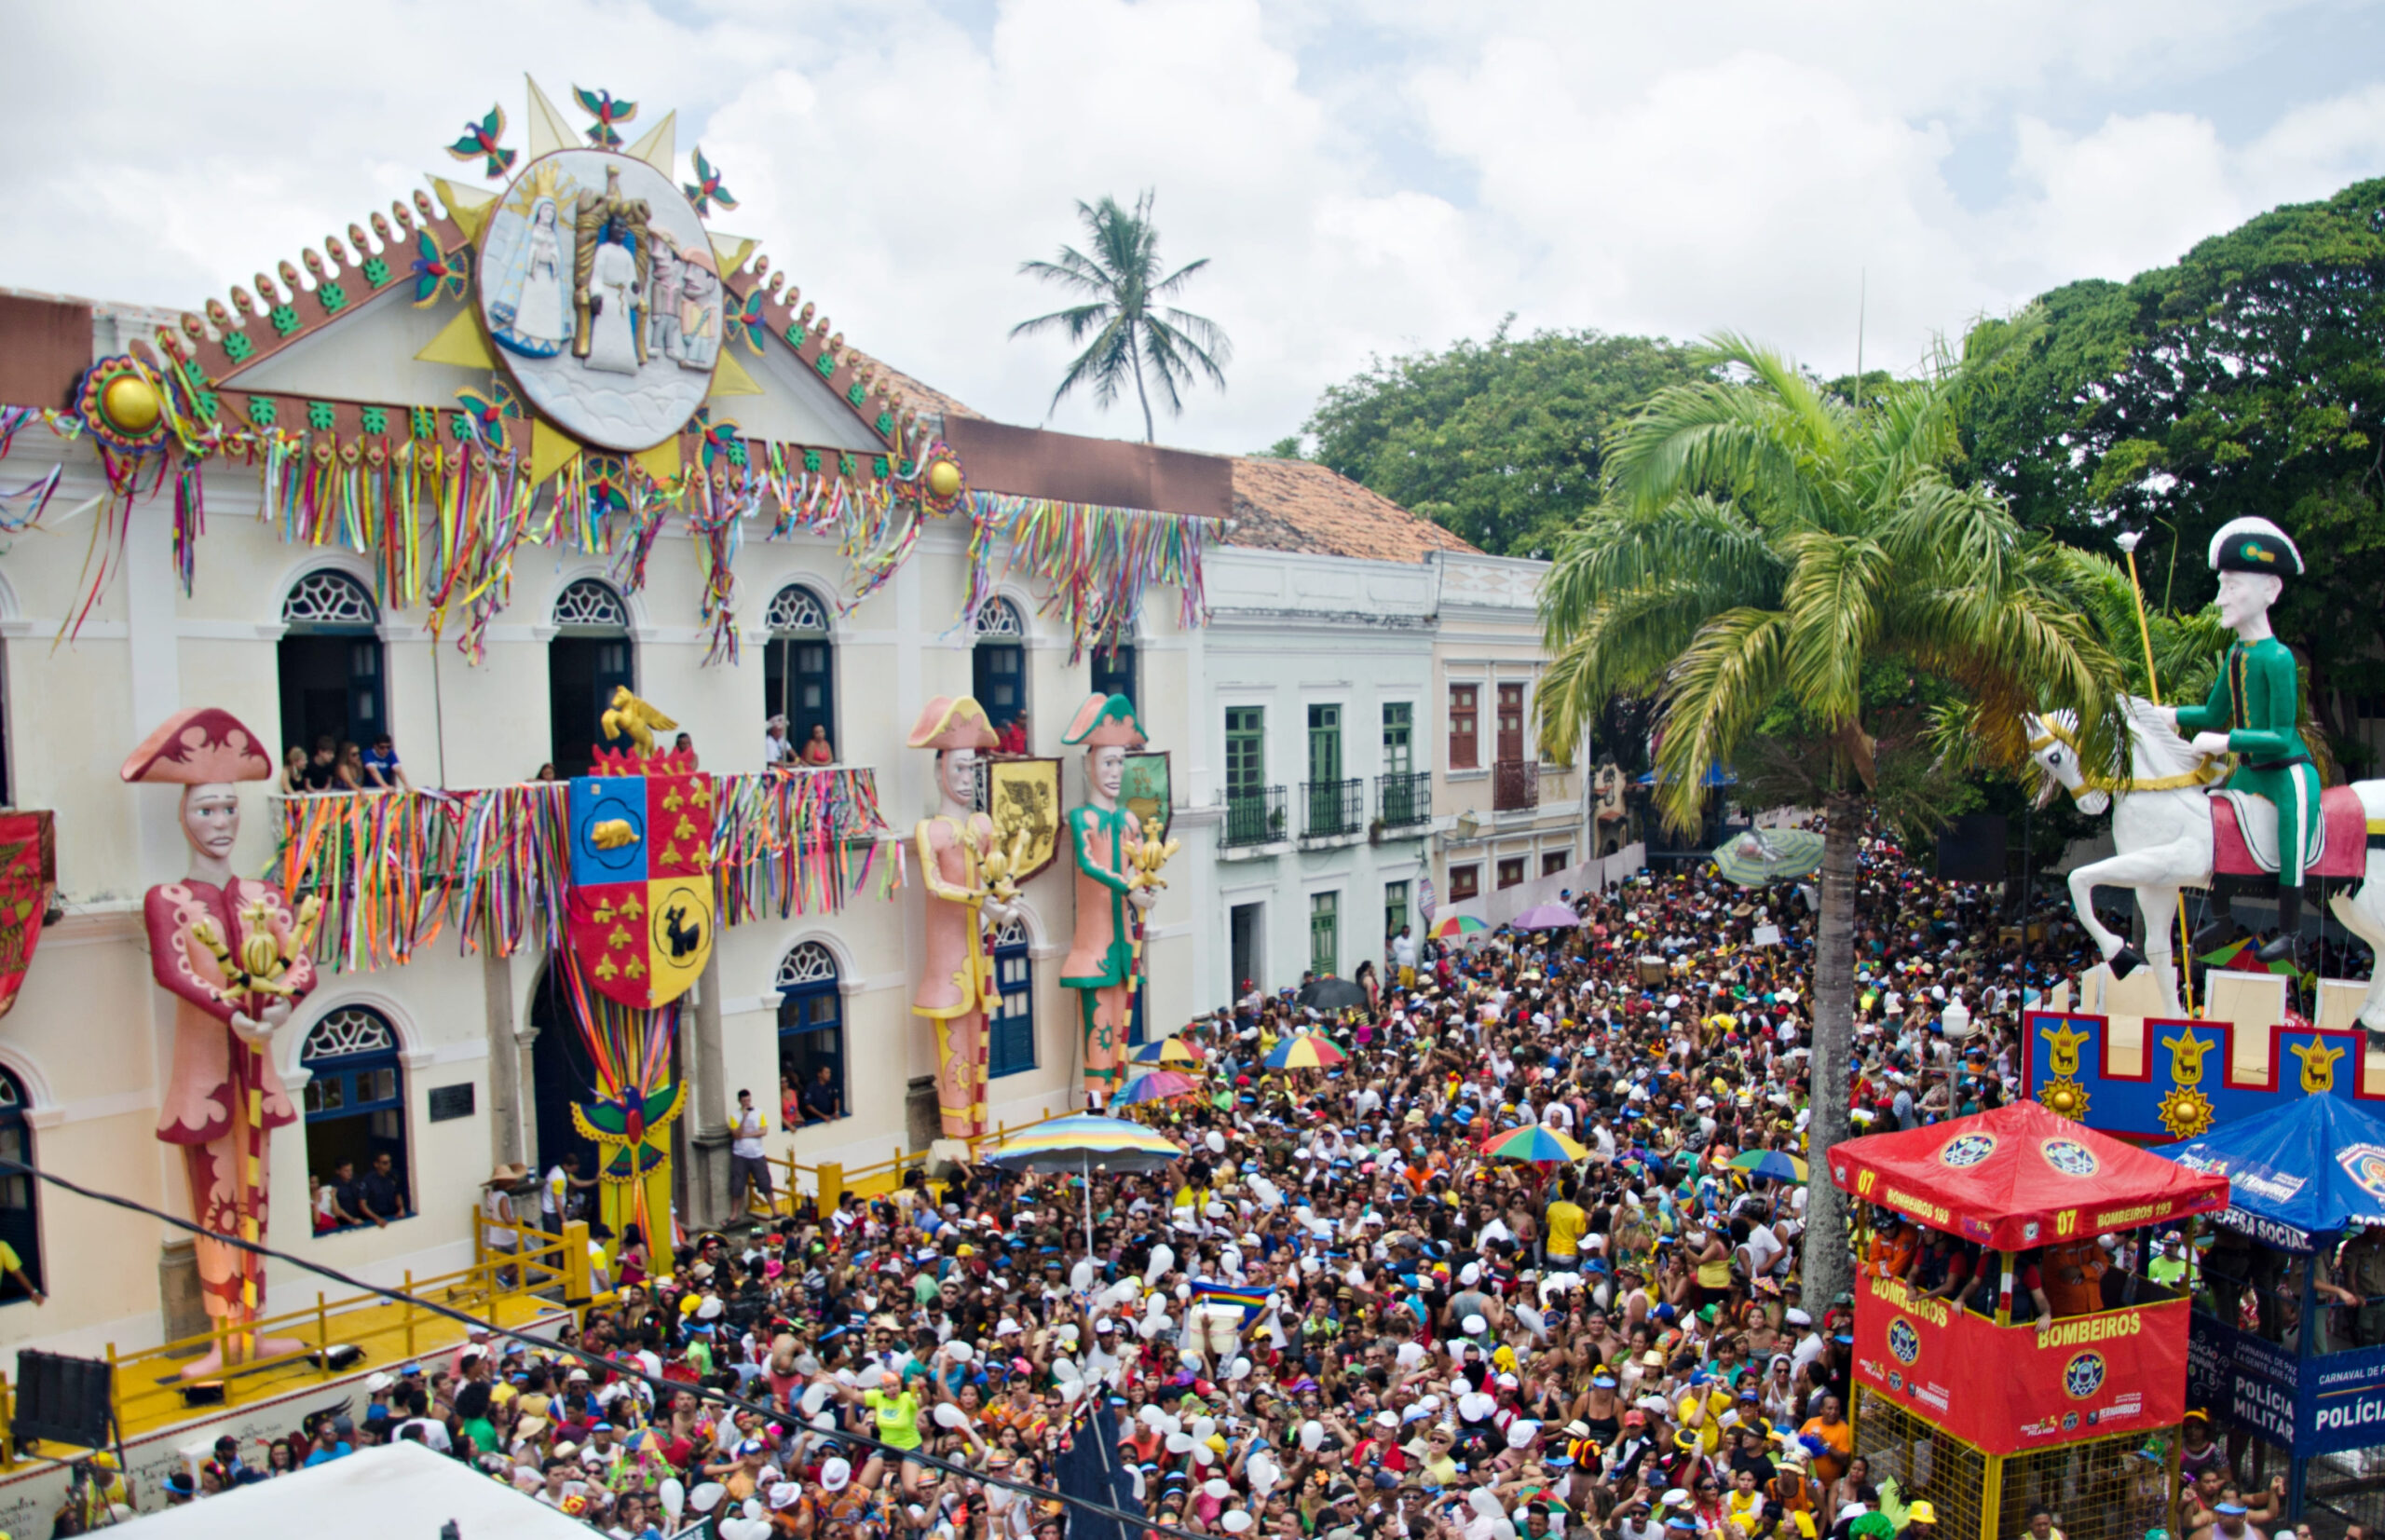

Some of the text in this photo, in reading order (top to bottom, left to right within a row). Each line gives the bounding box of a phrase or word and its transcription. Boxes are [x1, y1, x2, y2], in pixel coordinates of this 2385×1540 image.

[1858, 1169, 1875, 1195] 07
[1887, 1188, 1949, 1225] BOMBEIROS 193
[2057, 1209, 2078, 1236] 07
[2097, 1201, 2172, 1228] BOMBEIROS 193
[2257, 1219, 2313, 1250] SOCIAL
[1871, 1276, 1947, 1328] BOMBEIROS
[2037, 1312, 2141, 1349] BOMBEIROS
[2233, 1350, 2238, 1359] E
[2239, 1353, 2245, 1362] A
[2244, 1356, 2269, 1373] GENTE
[2269, 1366, 2283, 1379] QUE
[2236, 1341, 2298, 1376] CARNAVAL DE PAZ
[2319, 1370, 2365, 1385] CARNAVAL
[2367, 1366, 2379, 1377] DE
[2099, 1402, 2141, 1419] PERNAMBUCO
[2236, 1375, 2294, 1420] POLÍCIA
[2234, 1397, 2294, 1443] MILITAR
[2315, 1397, 2385, 1432] POLÍCI
